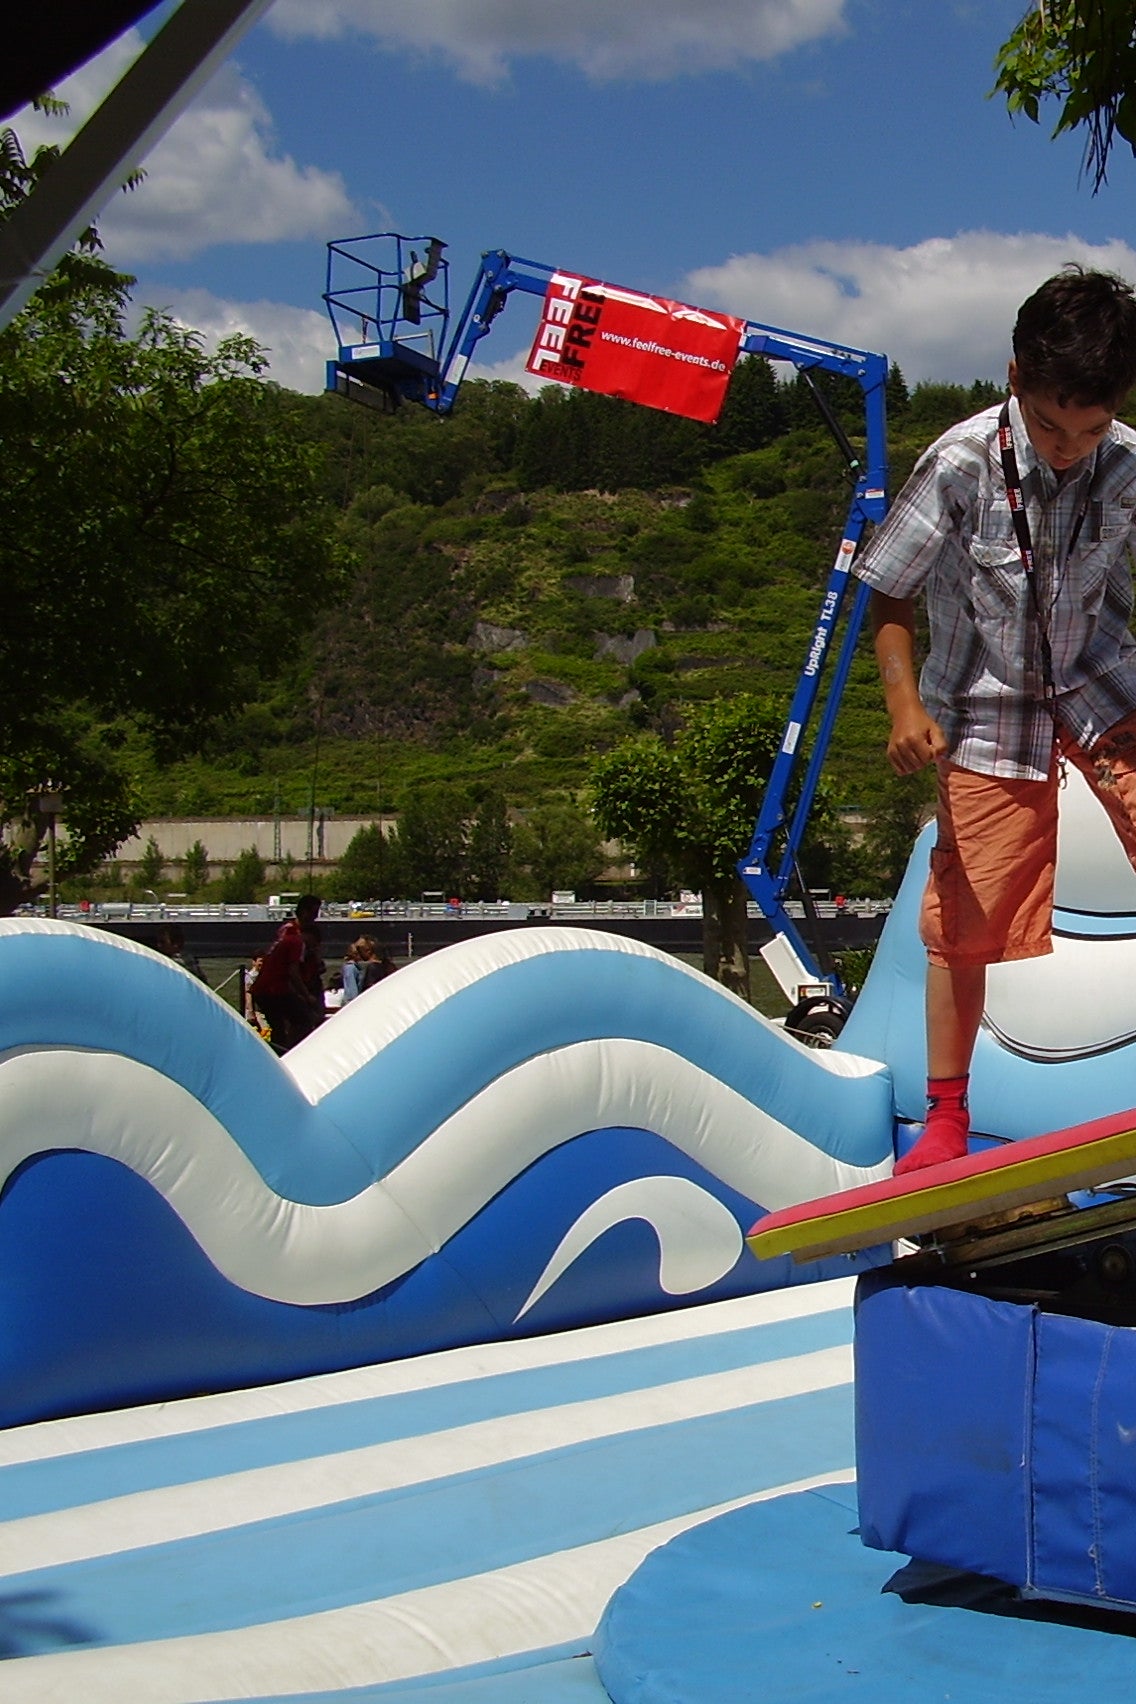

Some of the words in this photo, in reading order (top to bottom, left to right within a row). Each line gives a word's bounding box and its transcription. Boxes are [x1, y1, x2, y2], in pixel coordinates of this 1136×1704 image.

[532, 274, 582, 370] FEEL
[601, 331, 726, 372] www.feelfree-events.de
[541, 360, 582, 381] EVENTS
[804, 626, 828, 677] UpRight
[820, 591, 838, 621] TL38
